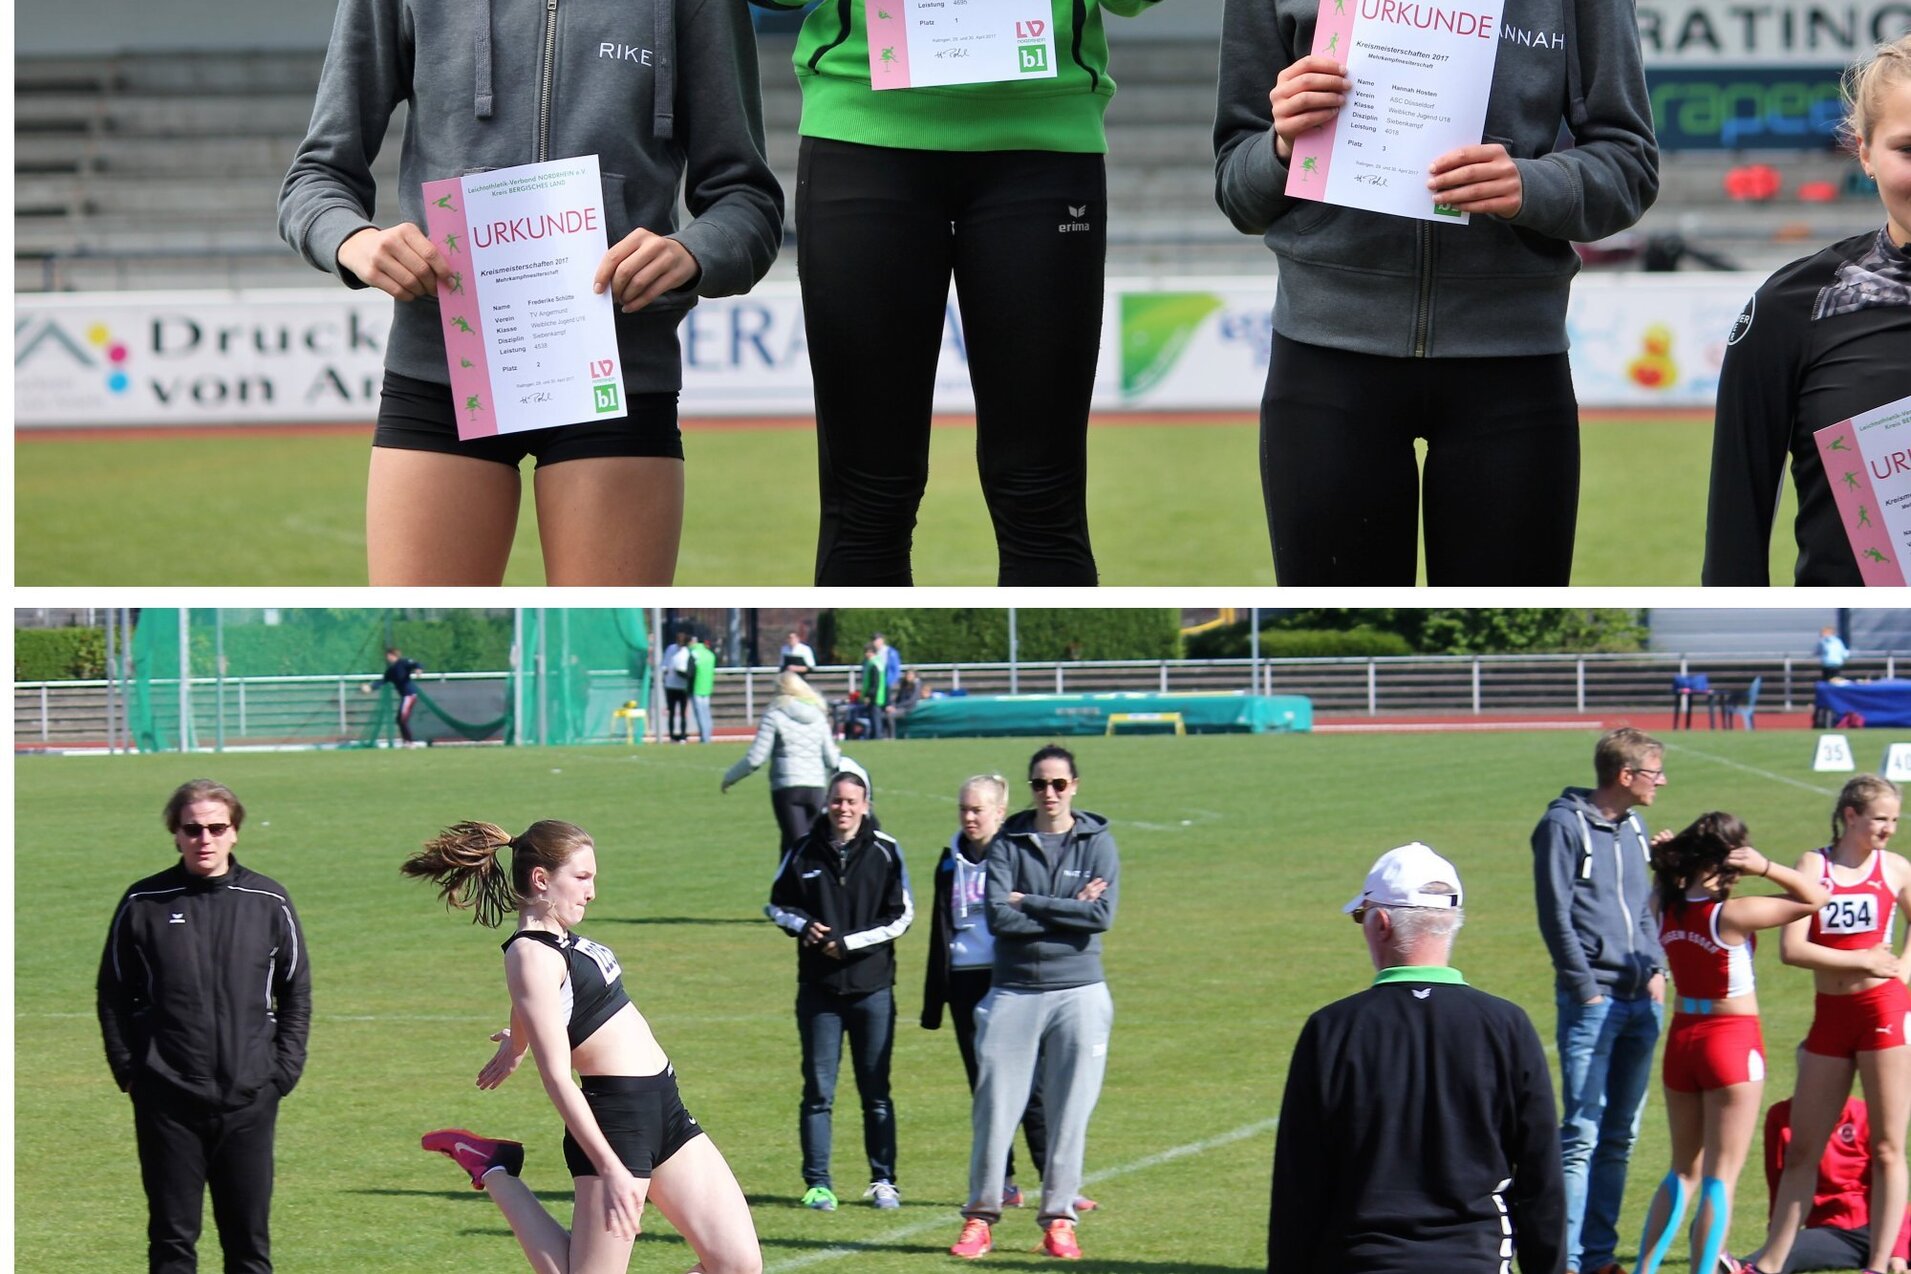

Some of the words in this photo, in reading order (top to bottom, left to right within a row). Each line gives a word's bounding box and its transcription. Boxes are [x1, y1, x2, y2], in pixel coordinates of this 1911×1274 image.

[1361, 0, 1493, 39] URKUNDE
[600, 42, 653, 67] RIKE
[1356, 41, 1431, 59] Kreismeisterschaften
[1432, 53, 1449, 62] 2017
[1355, 90, 1375, 99] Verein
[1357, 78, 1375, 87] Name
[1391, 84, 1415, 93] Hannah
[1415, 88, 1437, 98] Hosten
[1353, 101, 1375, 110] Klasse
[1389, 107, 1416, 118] Weibliche
[1416, 112, 1438, 121] Jugend
[1350, 122, 1377, 133] Leistung
[1385, 128, 1399, 136] 4018
[1352, 111, 1378, 121] Disziplin
[1386, 117, 1424, 130] Siebenkampf
[1347, 139, 1363, 148] Platz
[538, 171, 575, 182] NORDRHEIN
[492, 189, 508, 197] Kreis
[508, 183, 549, 194] BERGISCHES
[549, 180, 566, 188] LAND
[473, 207, 598, 248] URKUNDE
[1059, 221, 1090, 233] erima
[480, 260, 554, 277] Kreismeisterschaften
[554, 257, 569, 265] 2017
[493, 303, 511, 312] Name
[527, 297, 555, 306] Frederike
[494, 315, 515, 324] Verein
[149, 309, 380, 355] Druck
[496, 326, 517, 334] Klasse
[497, 335, 524, 345] Disziplin
[500, 346, 527, 356] Leistung
[502, 364, 518, 373] Platz
[149, 374, 276, 404] von
[595, 388, 617, 408] bl
[1823, 744, 1843, 761] 35
[1827, 901, 1871, 929] 254
